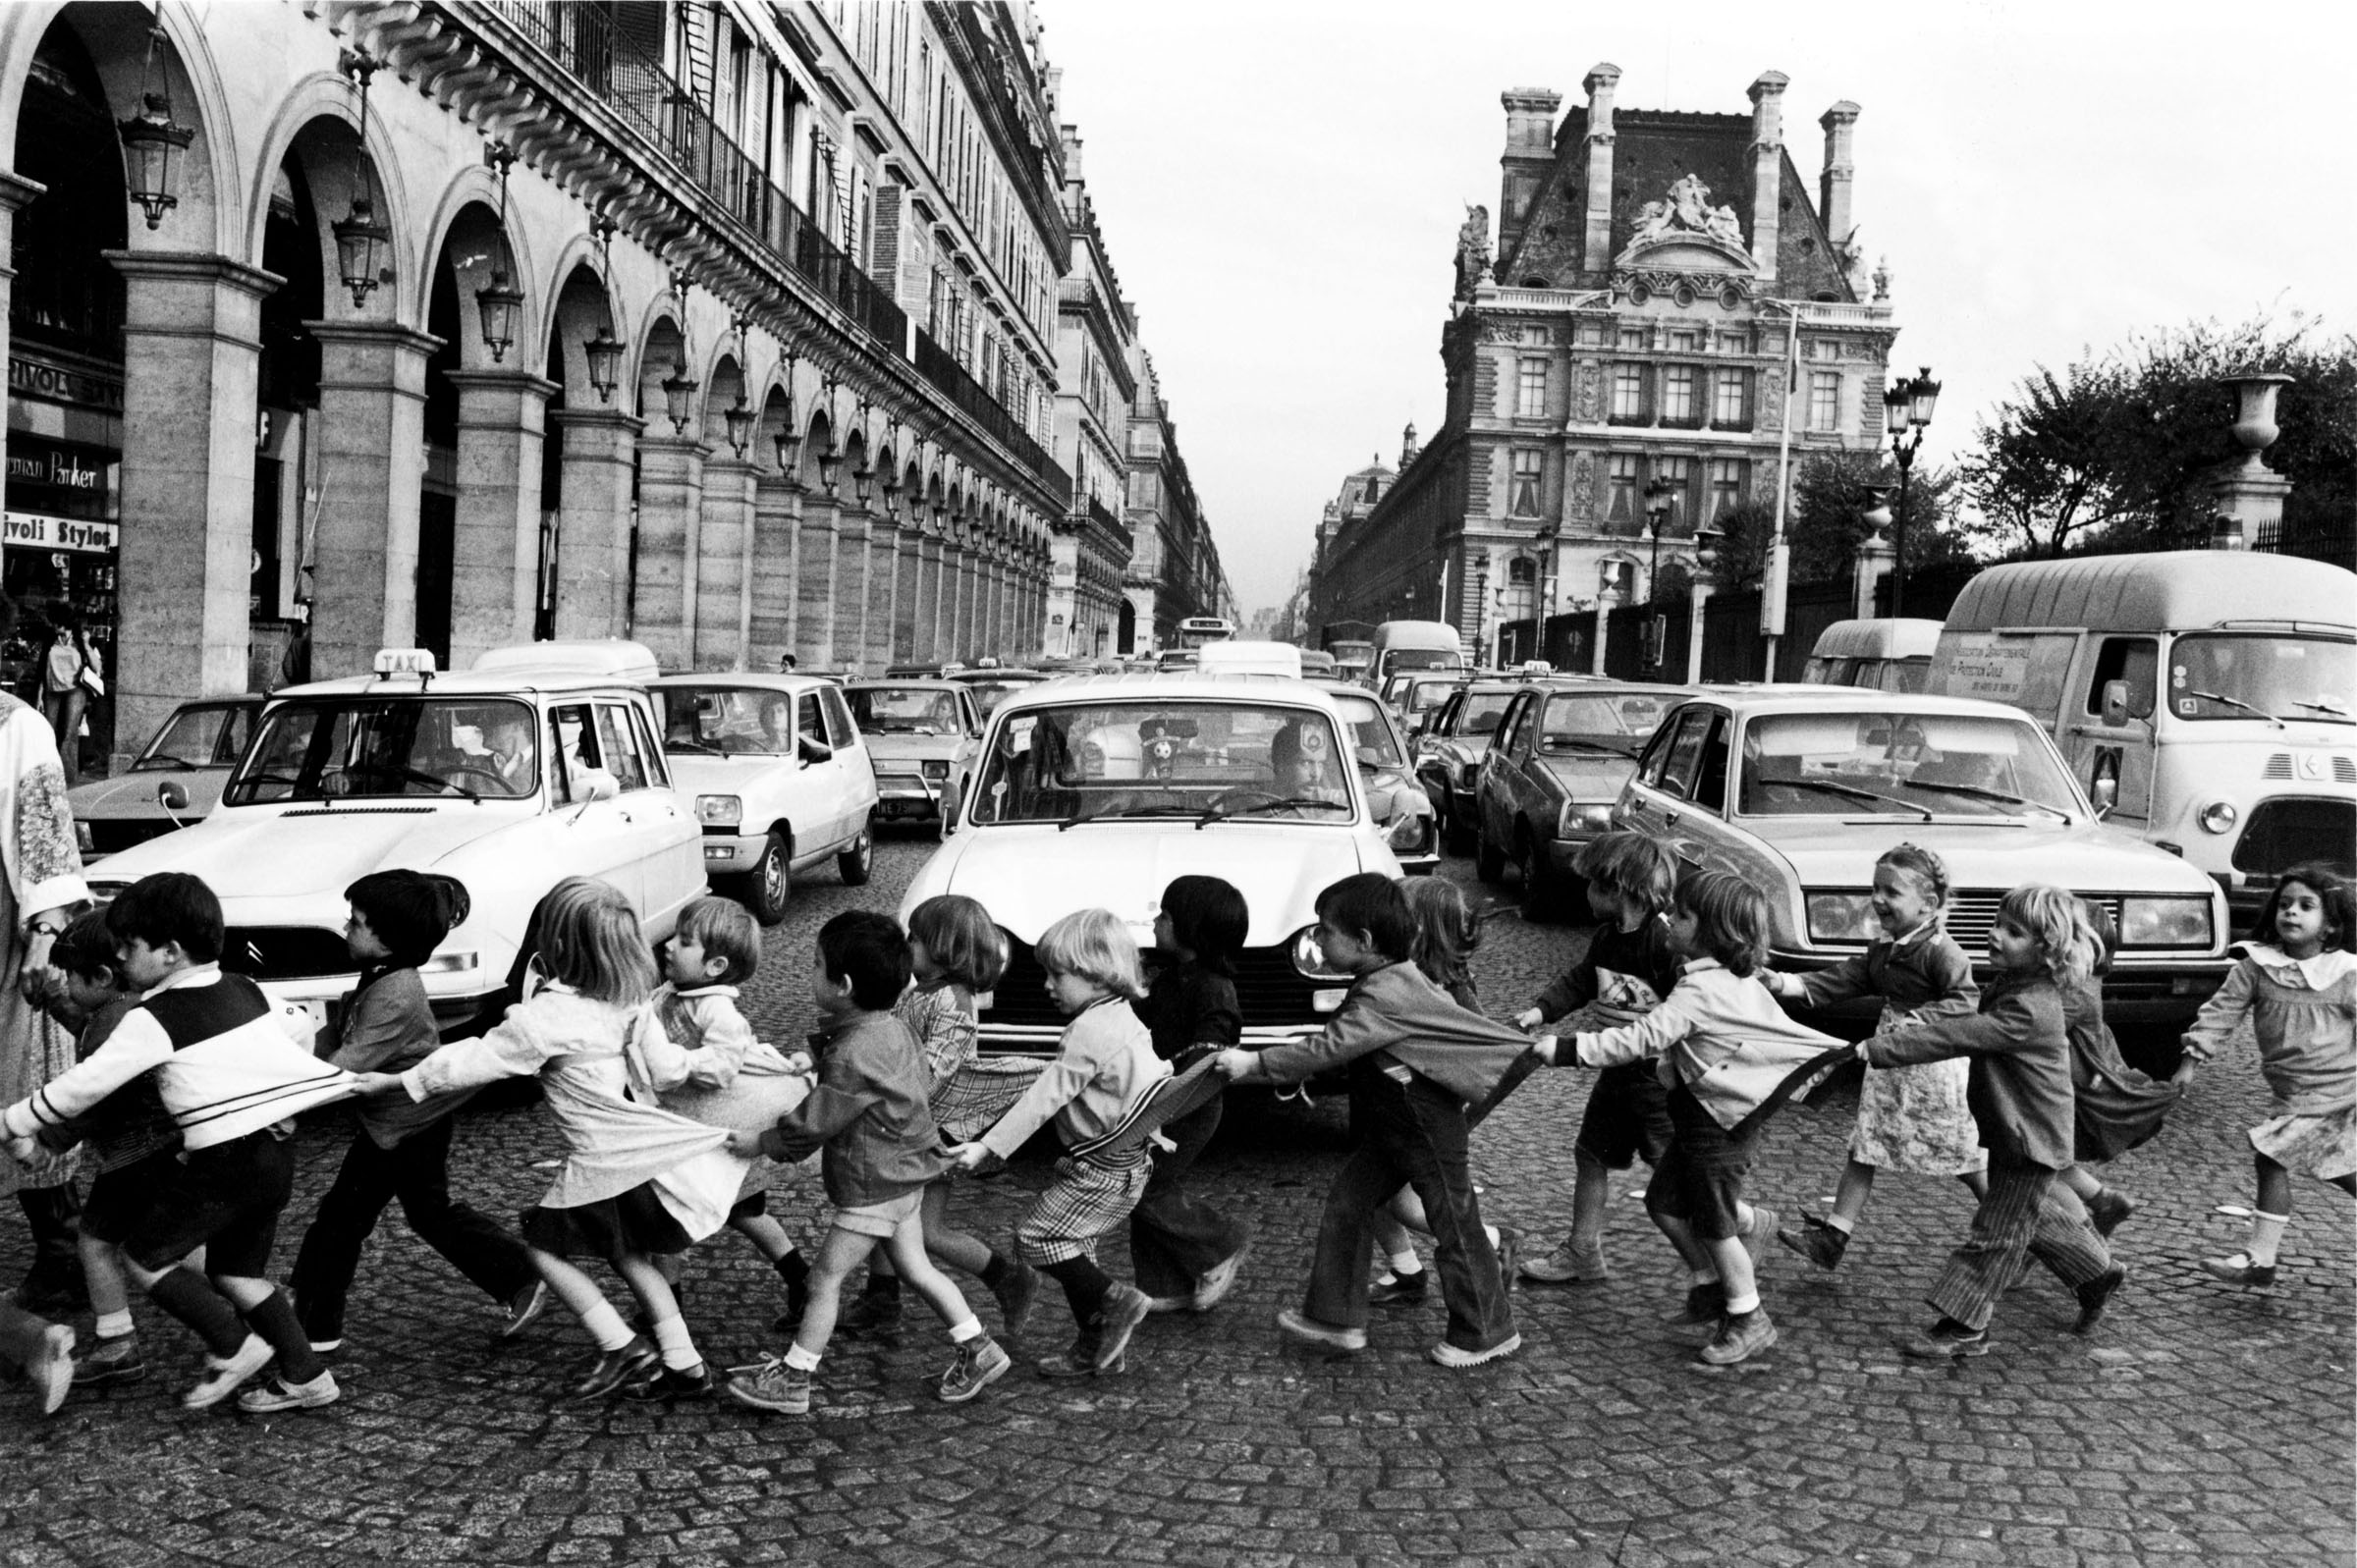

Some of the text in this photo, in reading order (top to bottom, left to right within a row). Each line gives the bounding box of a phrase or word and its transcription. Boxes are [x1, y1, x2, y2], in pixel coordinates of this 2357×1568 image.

[50, 451, 96, 488] Parker
[58, 521, 110, 549] Stylos
[383, 655, 422, 672] TAXI
